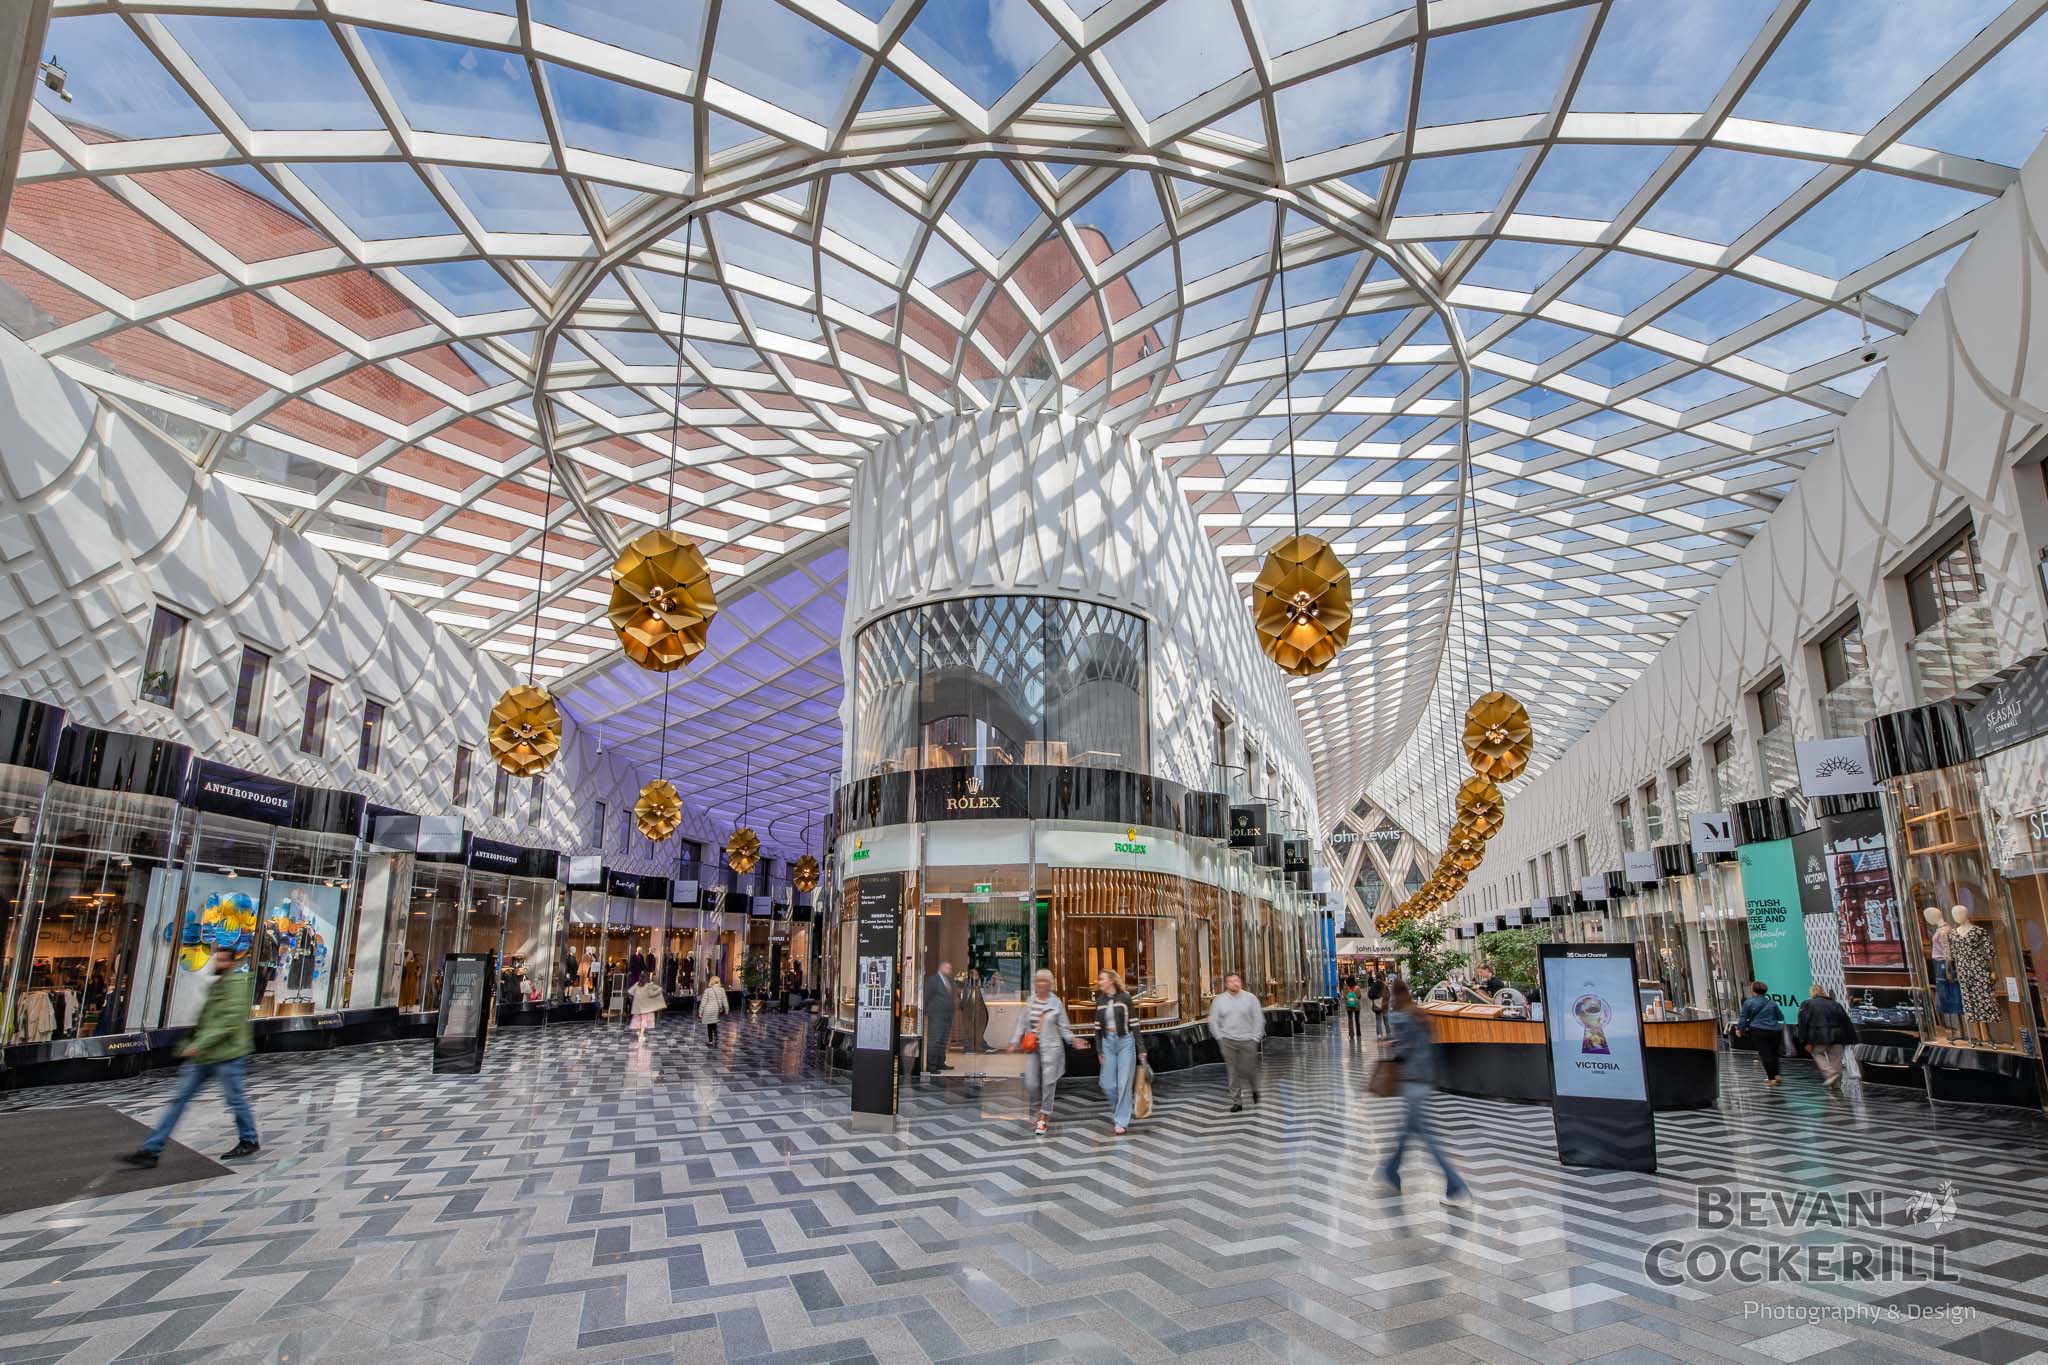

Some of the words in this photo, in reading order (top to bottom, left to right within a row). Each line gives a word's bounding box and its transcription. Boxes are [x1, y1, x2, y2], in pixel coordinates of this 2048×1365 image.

[1986, 700, 2022, 728] SEASALT
[204, 782, 289, 808] ANTHROPOLOGIE
[946, 797, 1001, 810] ROLEX
[1330, 829, 1359, 845] John
[1364, 827, 1401, 842] Lewis
[1114, 842, 1147, 855] ROLEX
[475, 850, 518, 864] ANTHROPOLOGIE
[1804, 872, 1828, 885] VICTORIA
[1755, 907, 1787, 915] DINING
[1765, 914, 1786, 922] AND
[1356, 945, 1372, 953] John
[1576, 1062, 1620, 1071] VICTORIA
